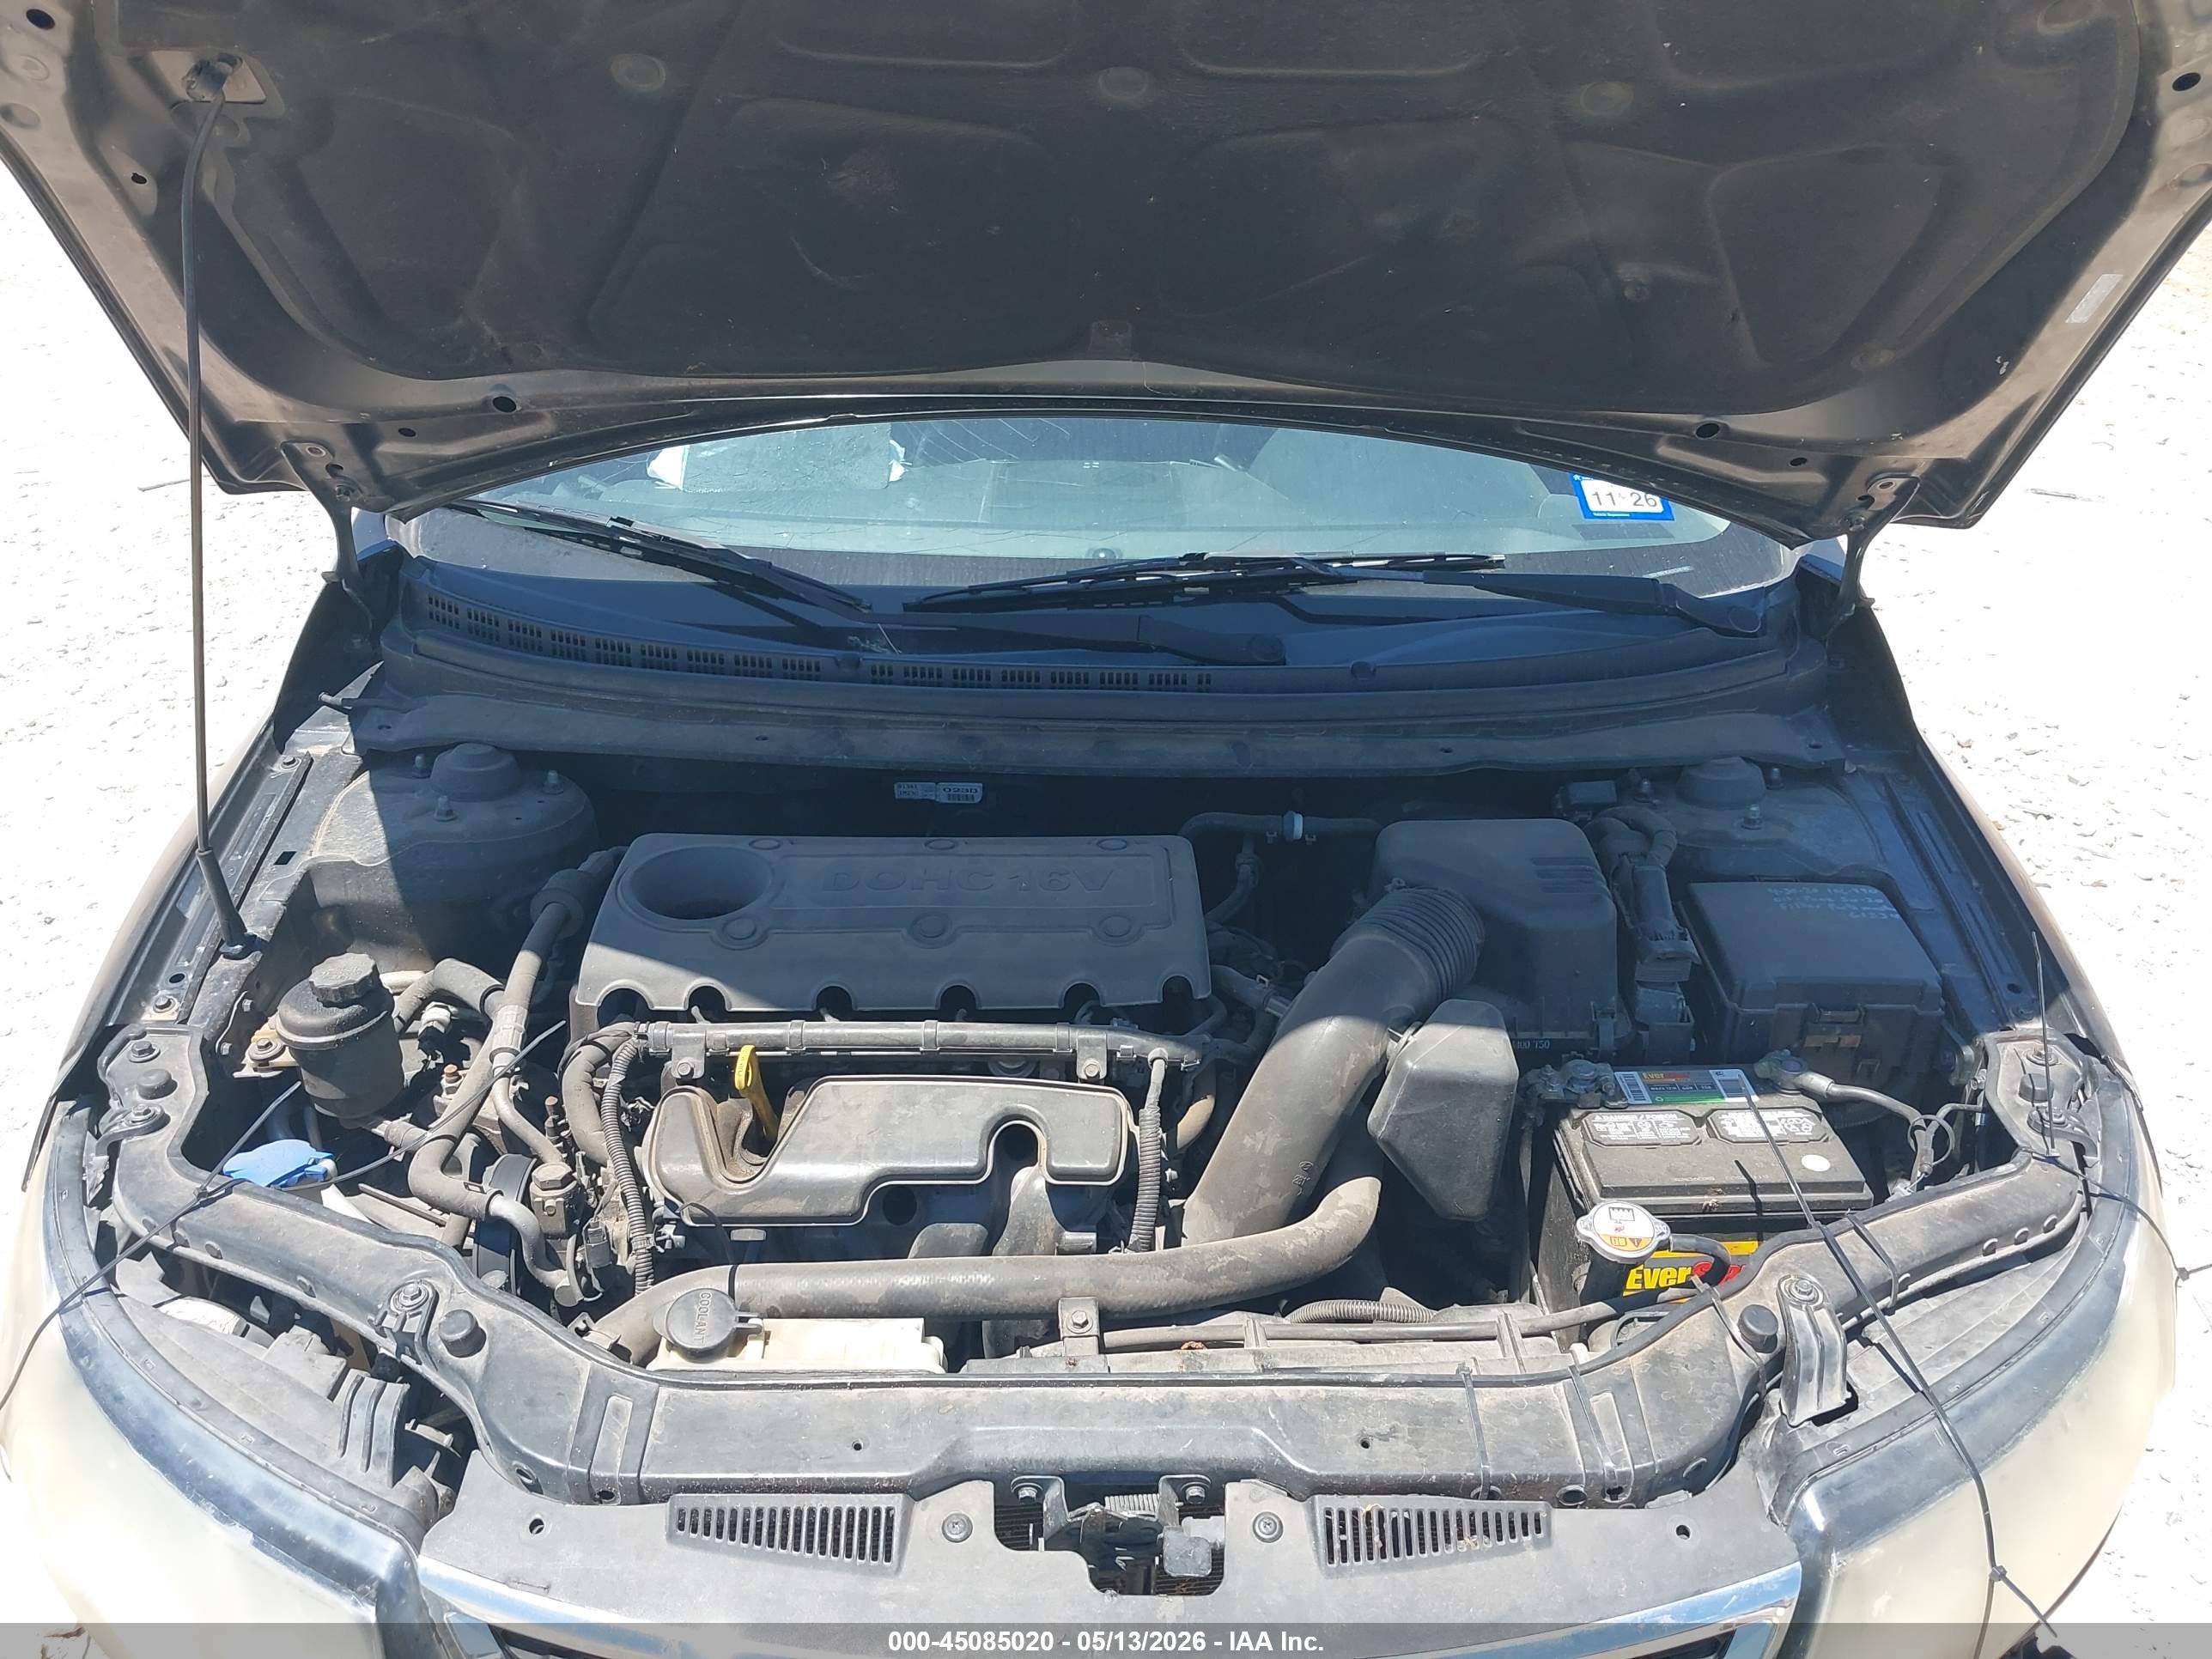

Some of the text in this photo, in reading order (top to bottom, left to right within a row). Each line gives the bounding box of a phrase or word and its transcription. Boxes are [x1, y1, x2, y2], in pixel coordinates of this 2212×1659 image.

[1592, 491, 1657, 507] 11 26
[822, 867, 1115, 892] DOHC 16V
[693, 1291, 712, 1344] COOLANT
